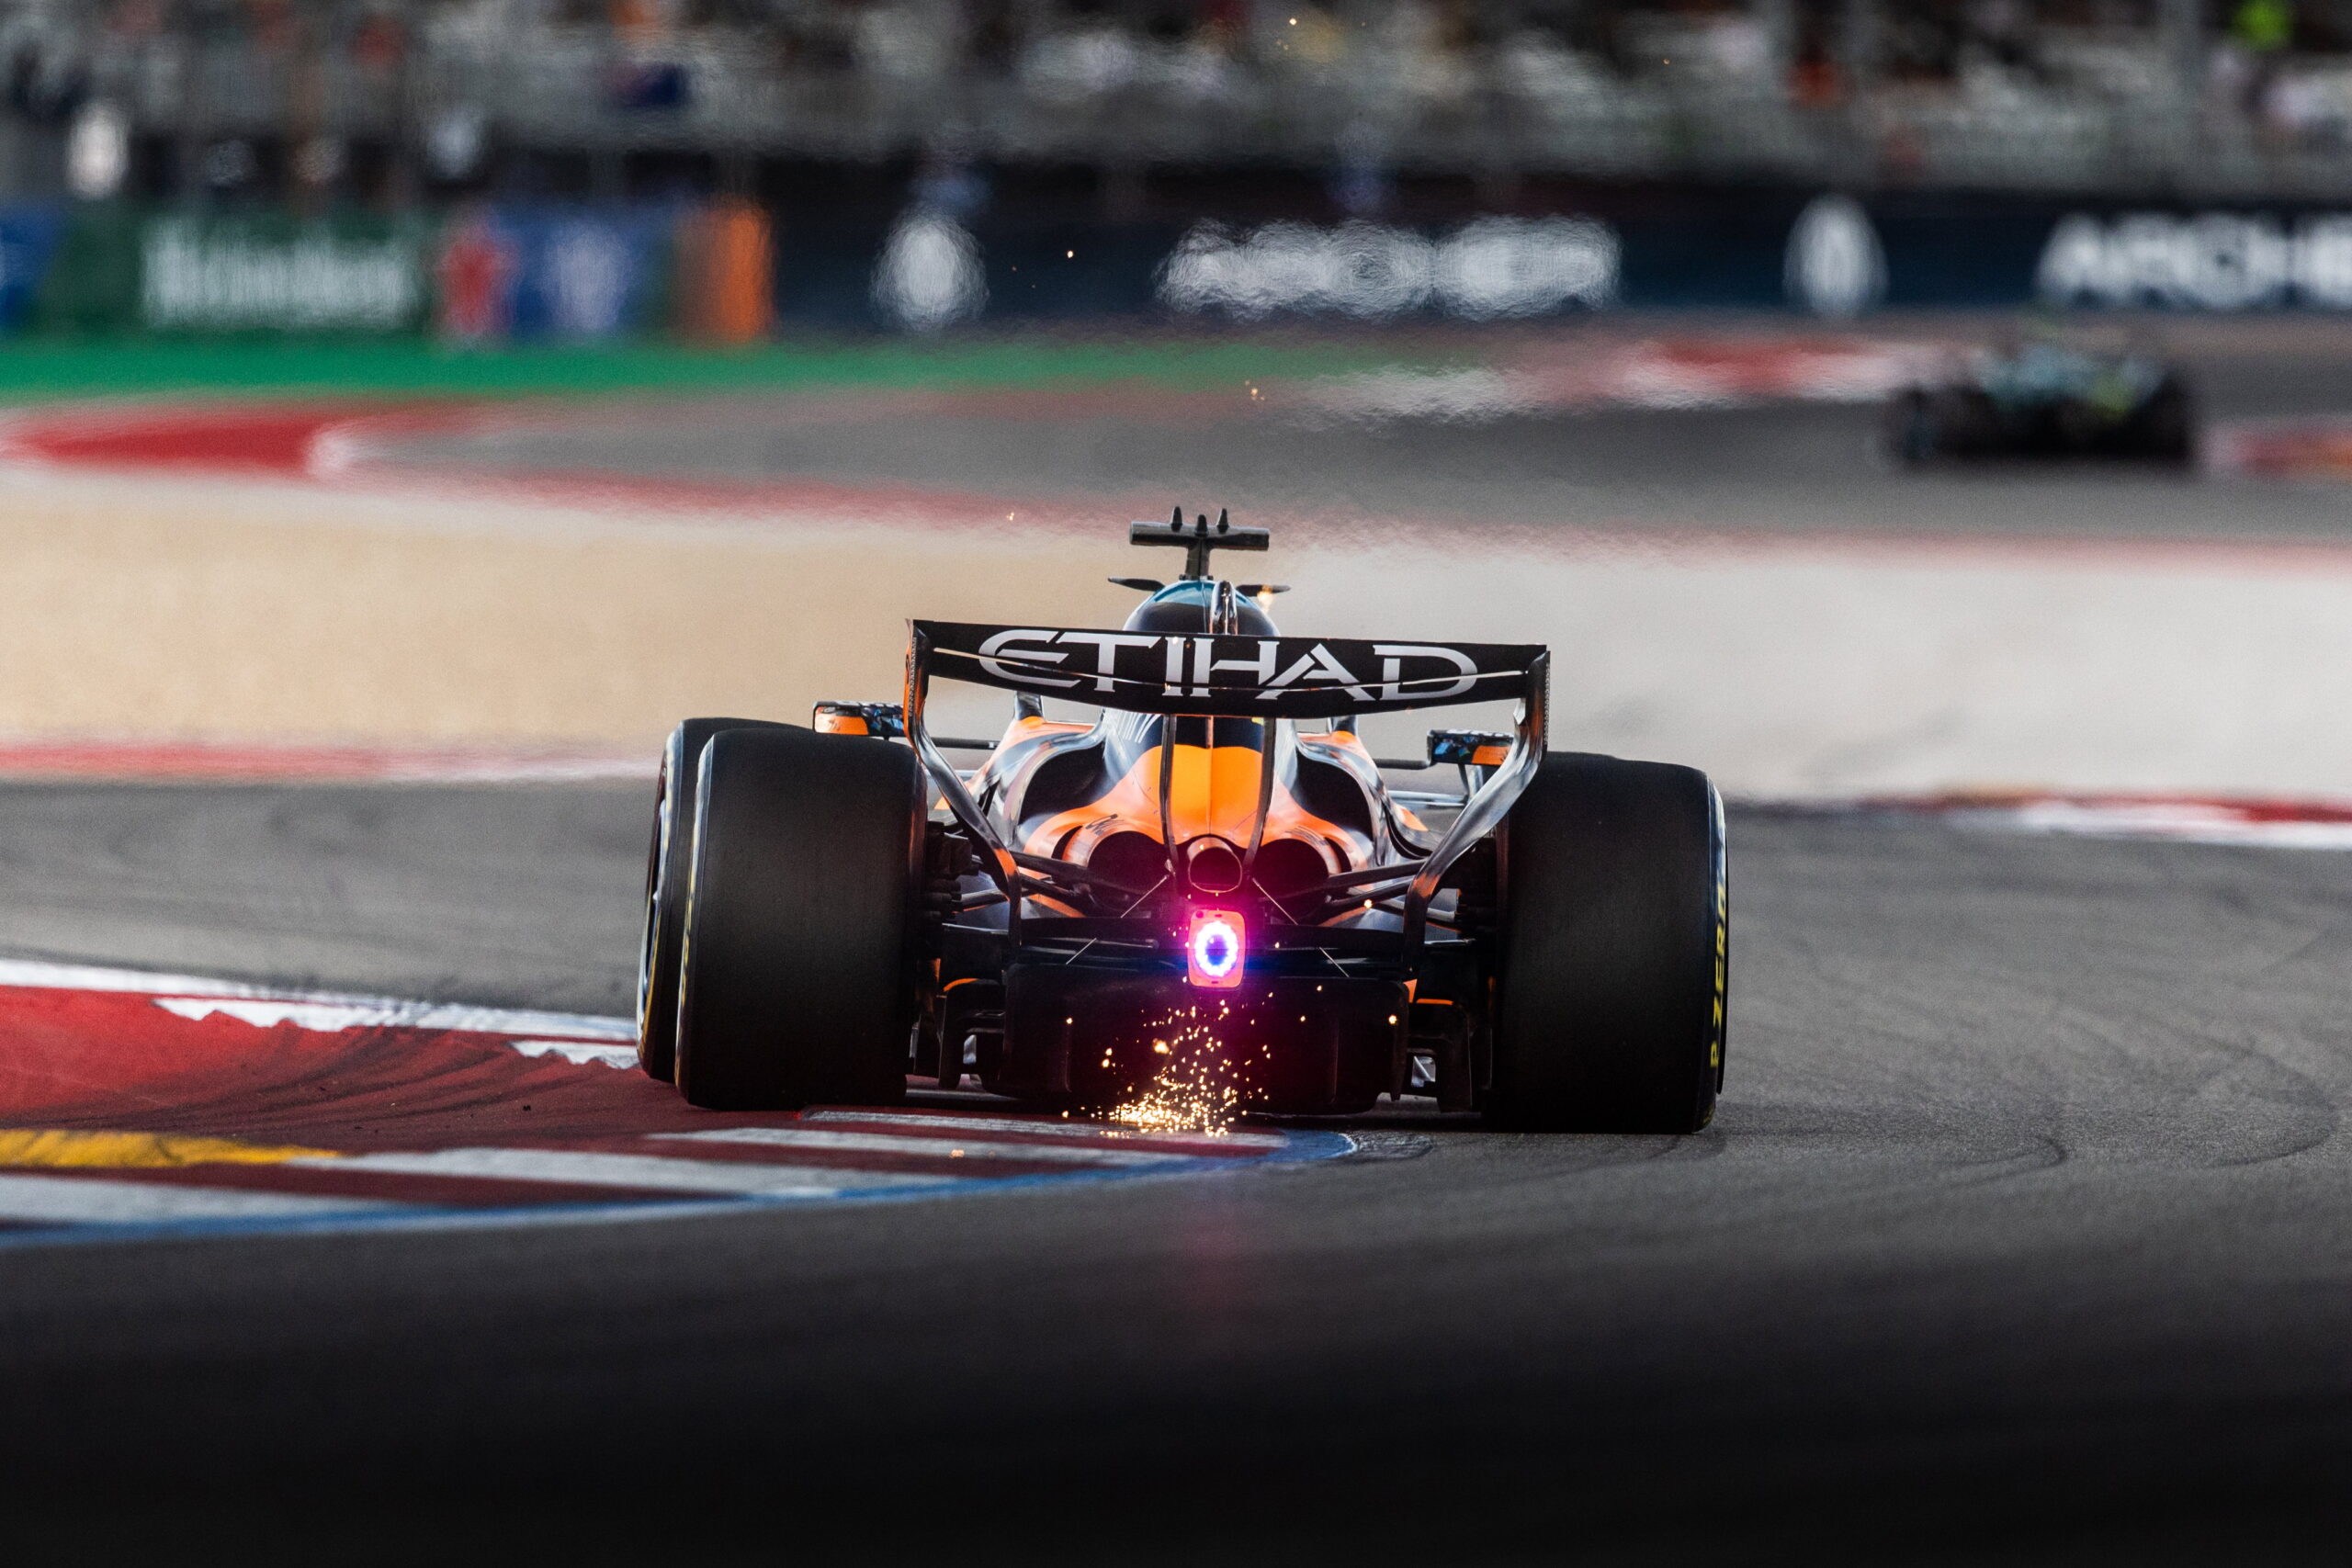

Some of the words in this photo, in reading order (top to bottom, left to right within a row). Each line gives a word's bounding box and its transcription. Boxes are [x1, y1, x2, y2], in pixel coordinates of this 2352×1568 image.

[978, 629, 1478, 702] ETIHAD
[1713, 880, 1726, 1028] ZERO
[1711, 1041, 1719, 1067] P
